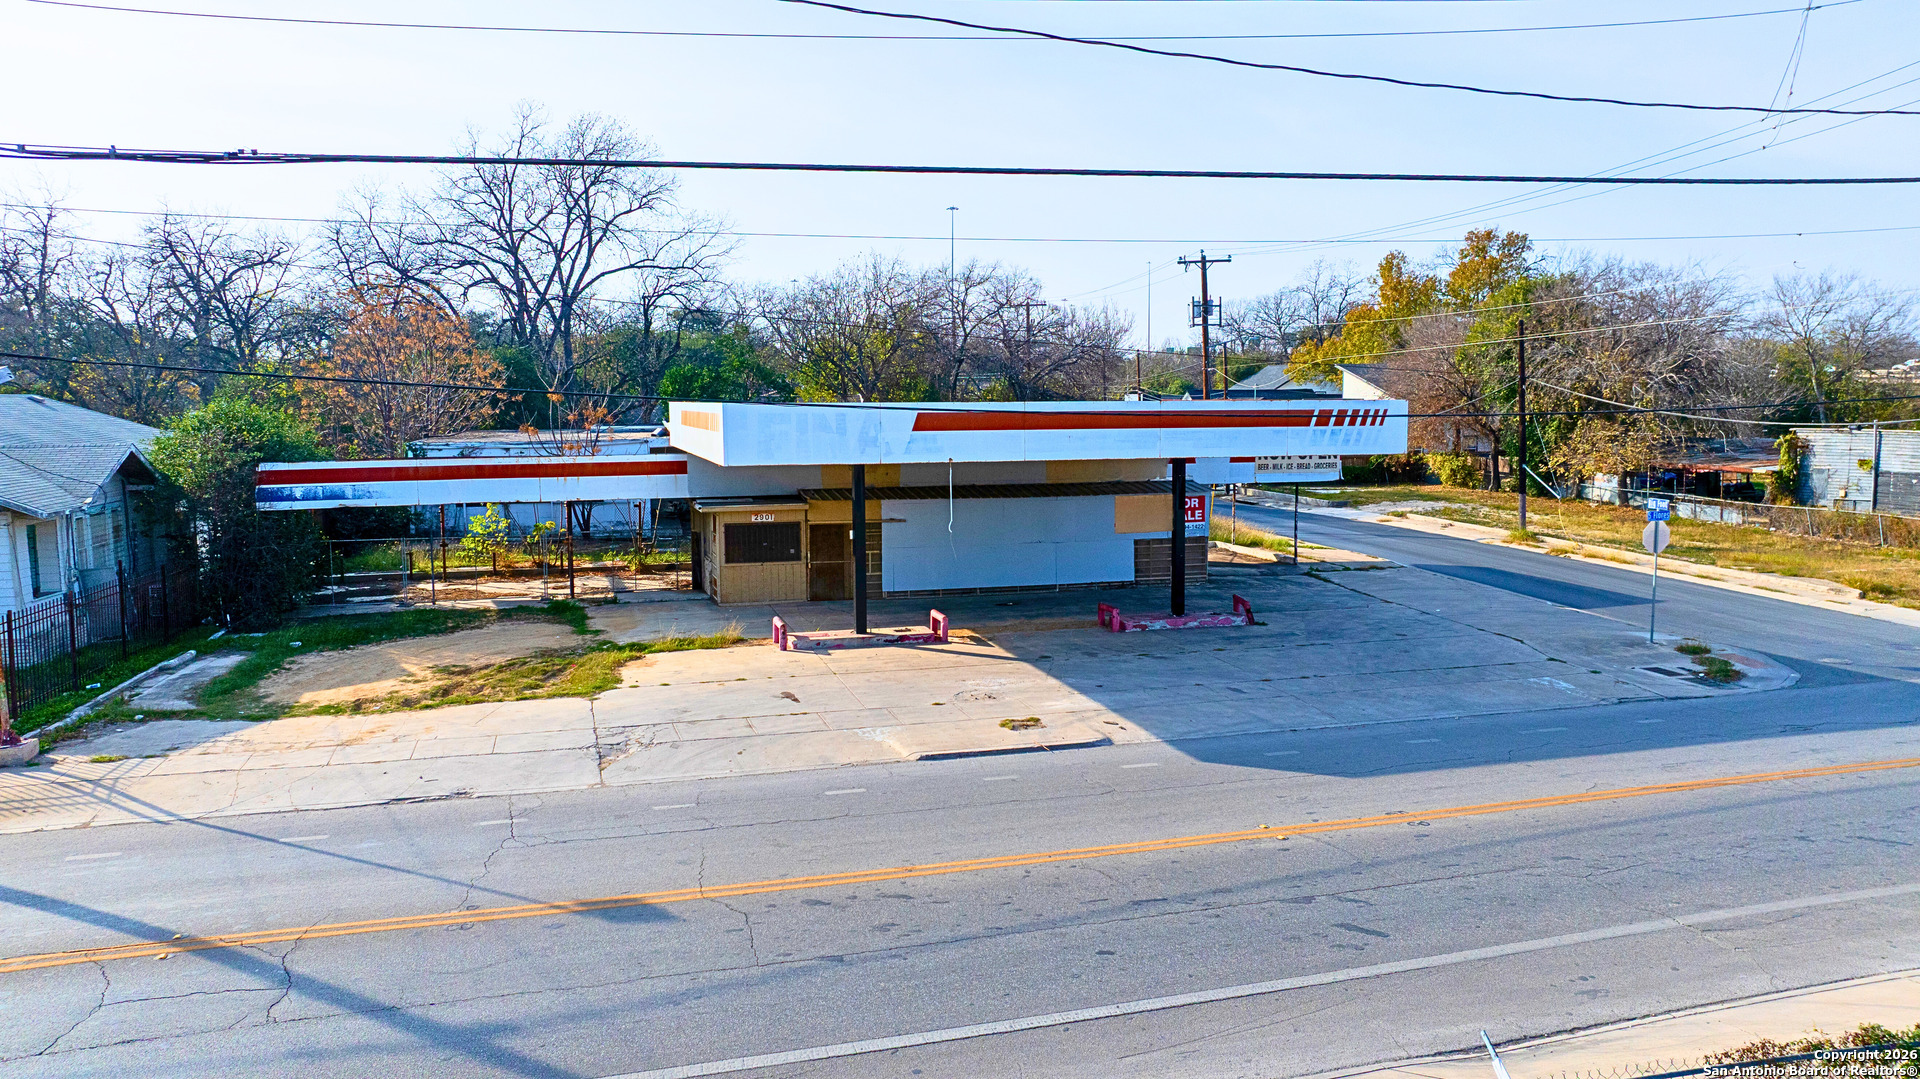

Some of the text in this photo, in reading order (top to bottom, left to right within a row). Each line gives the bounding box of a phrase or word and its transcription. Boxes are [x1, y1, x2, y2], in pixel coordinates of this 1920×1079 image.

[1185, 498, 1199, 508] OR
[754, 513, 773, 521] 2901
[1185, 510, 1203, 520] LE
[1653, 511, 1670, 519] Flores
